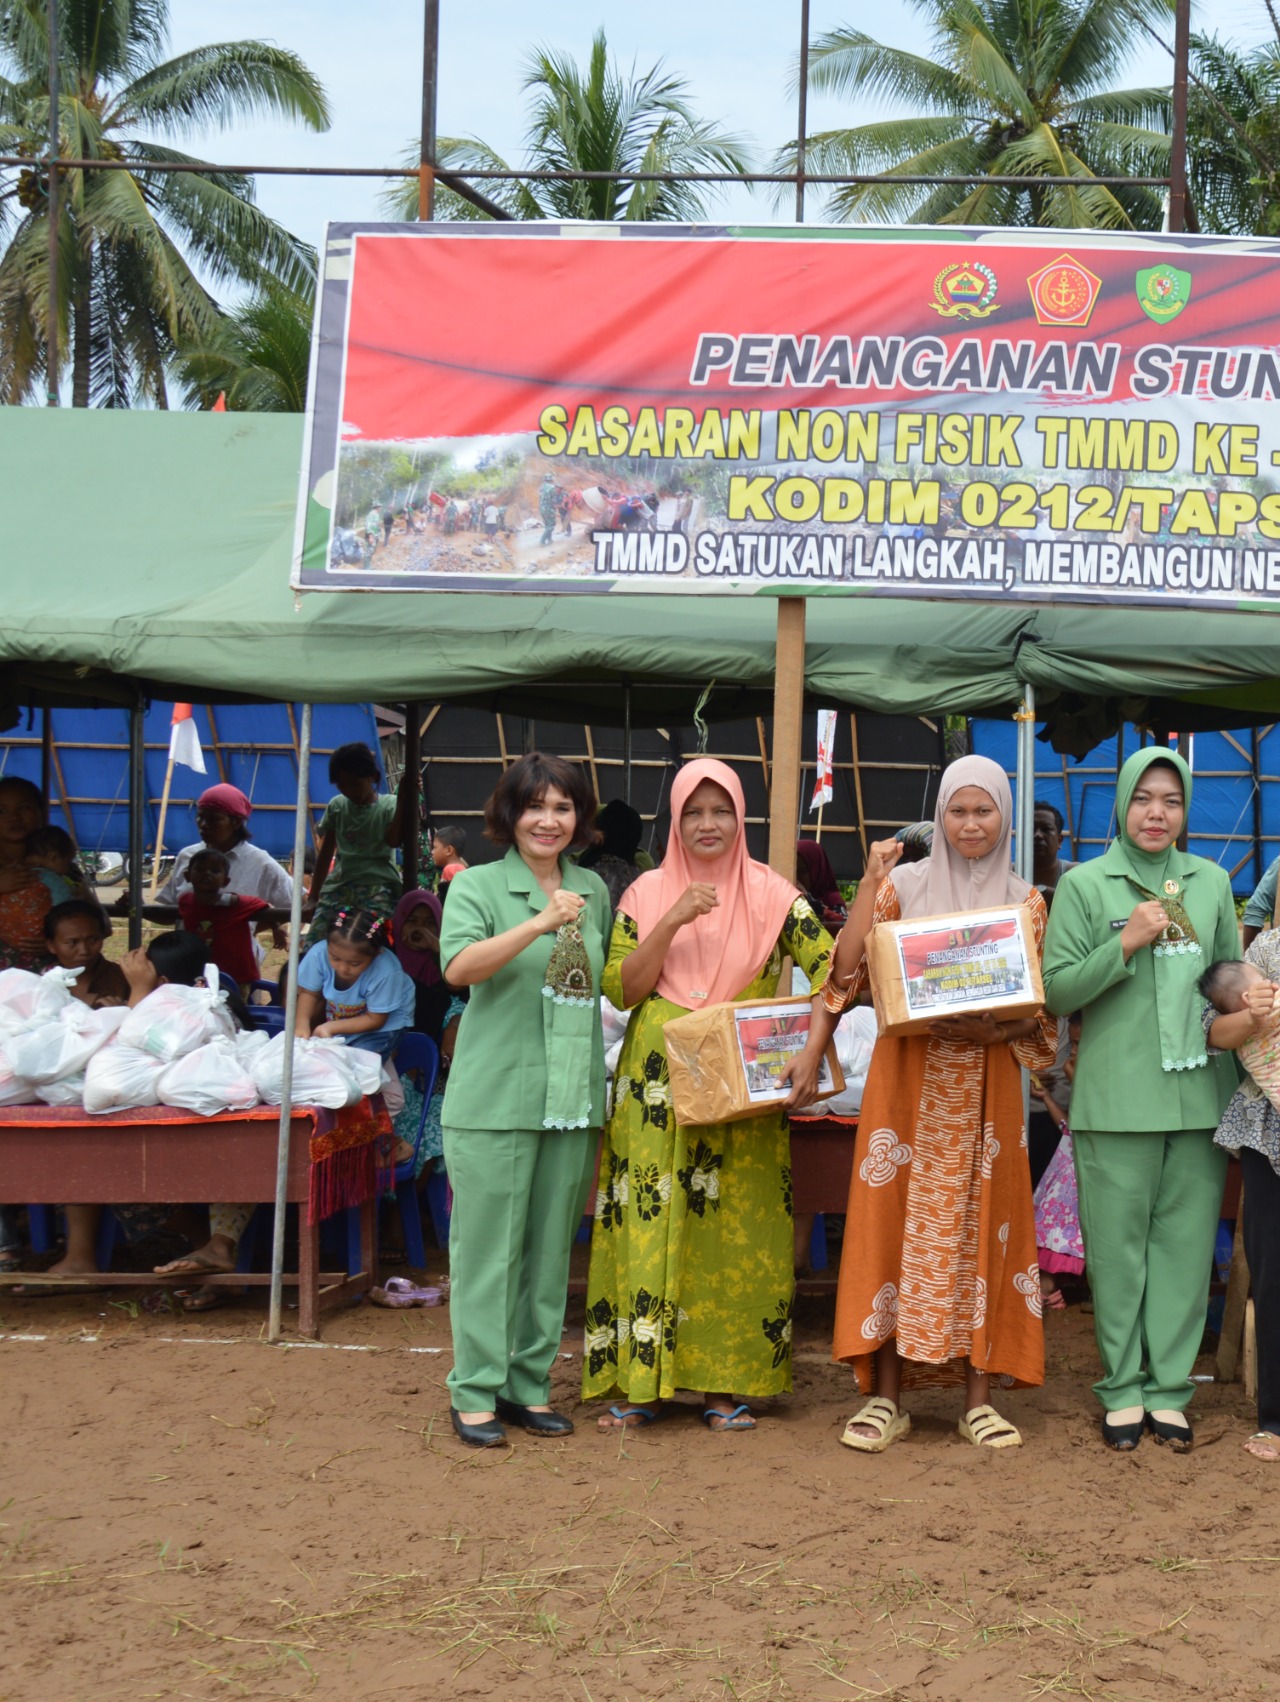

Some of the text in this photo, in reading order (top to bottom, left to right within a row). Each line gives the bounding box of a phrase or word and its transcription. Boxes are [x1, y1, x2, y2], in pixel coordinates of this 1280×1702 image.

[691, 333, 1117, 394] PENANGANAN
[538, 405, 764, 460] SASARAN
[777, 410, 882, 463] NON
[895, 412, 1023, 467] FISIK
[1036, 416, 1180, 473] TMMD
[1194, 421, 1260, 477] KE
[728, 476, 943, 524] KODIM
[592, 532, 690, 575] TMMD
[697, 533, 847, 577] SATUKAN
[853, 535, 1014, 590] LANGKAH,
[1023, 541, 1236, 588] MEMBANGUN
[969, 943, 999, 958] STUNTING
